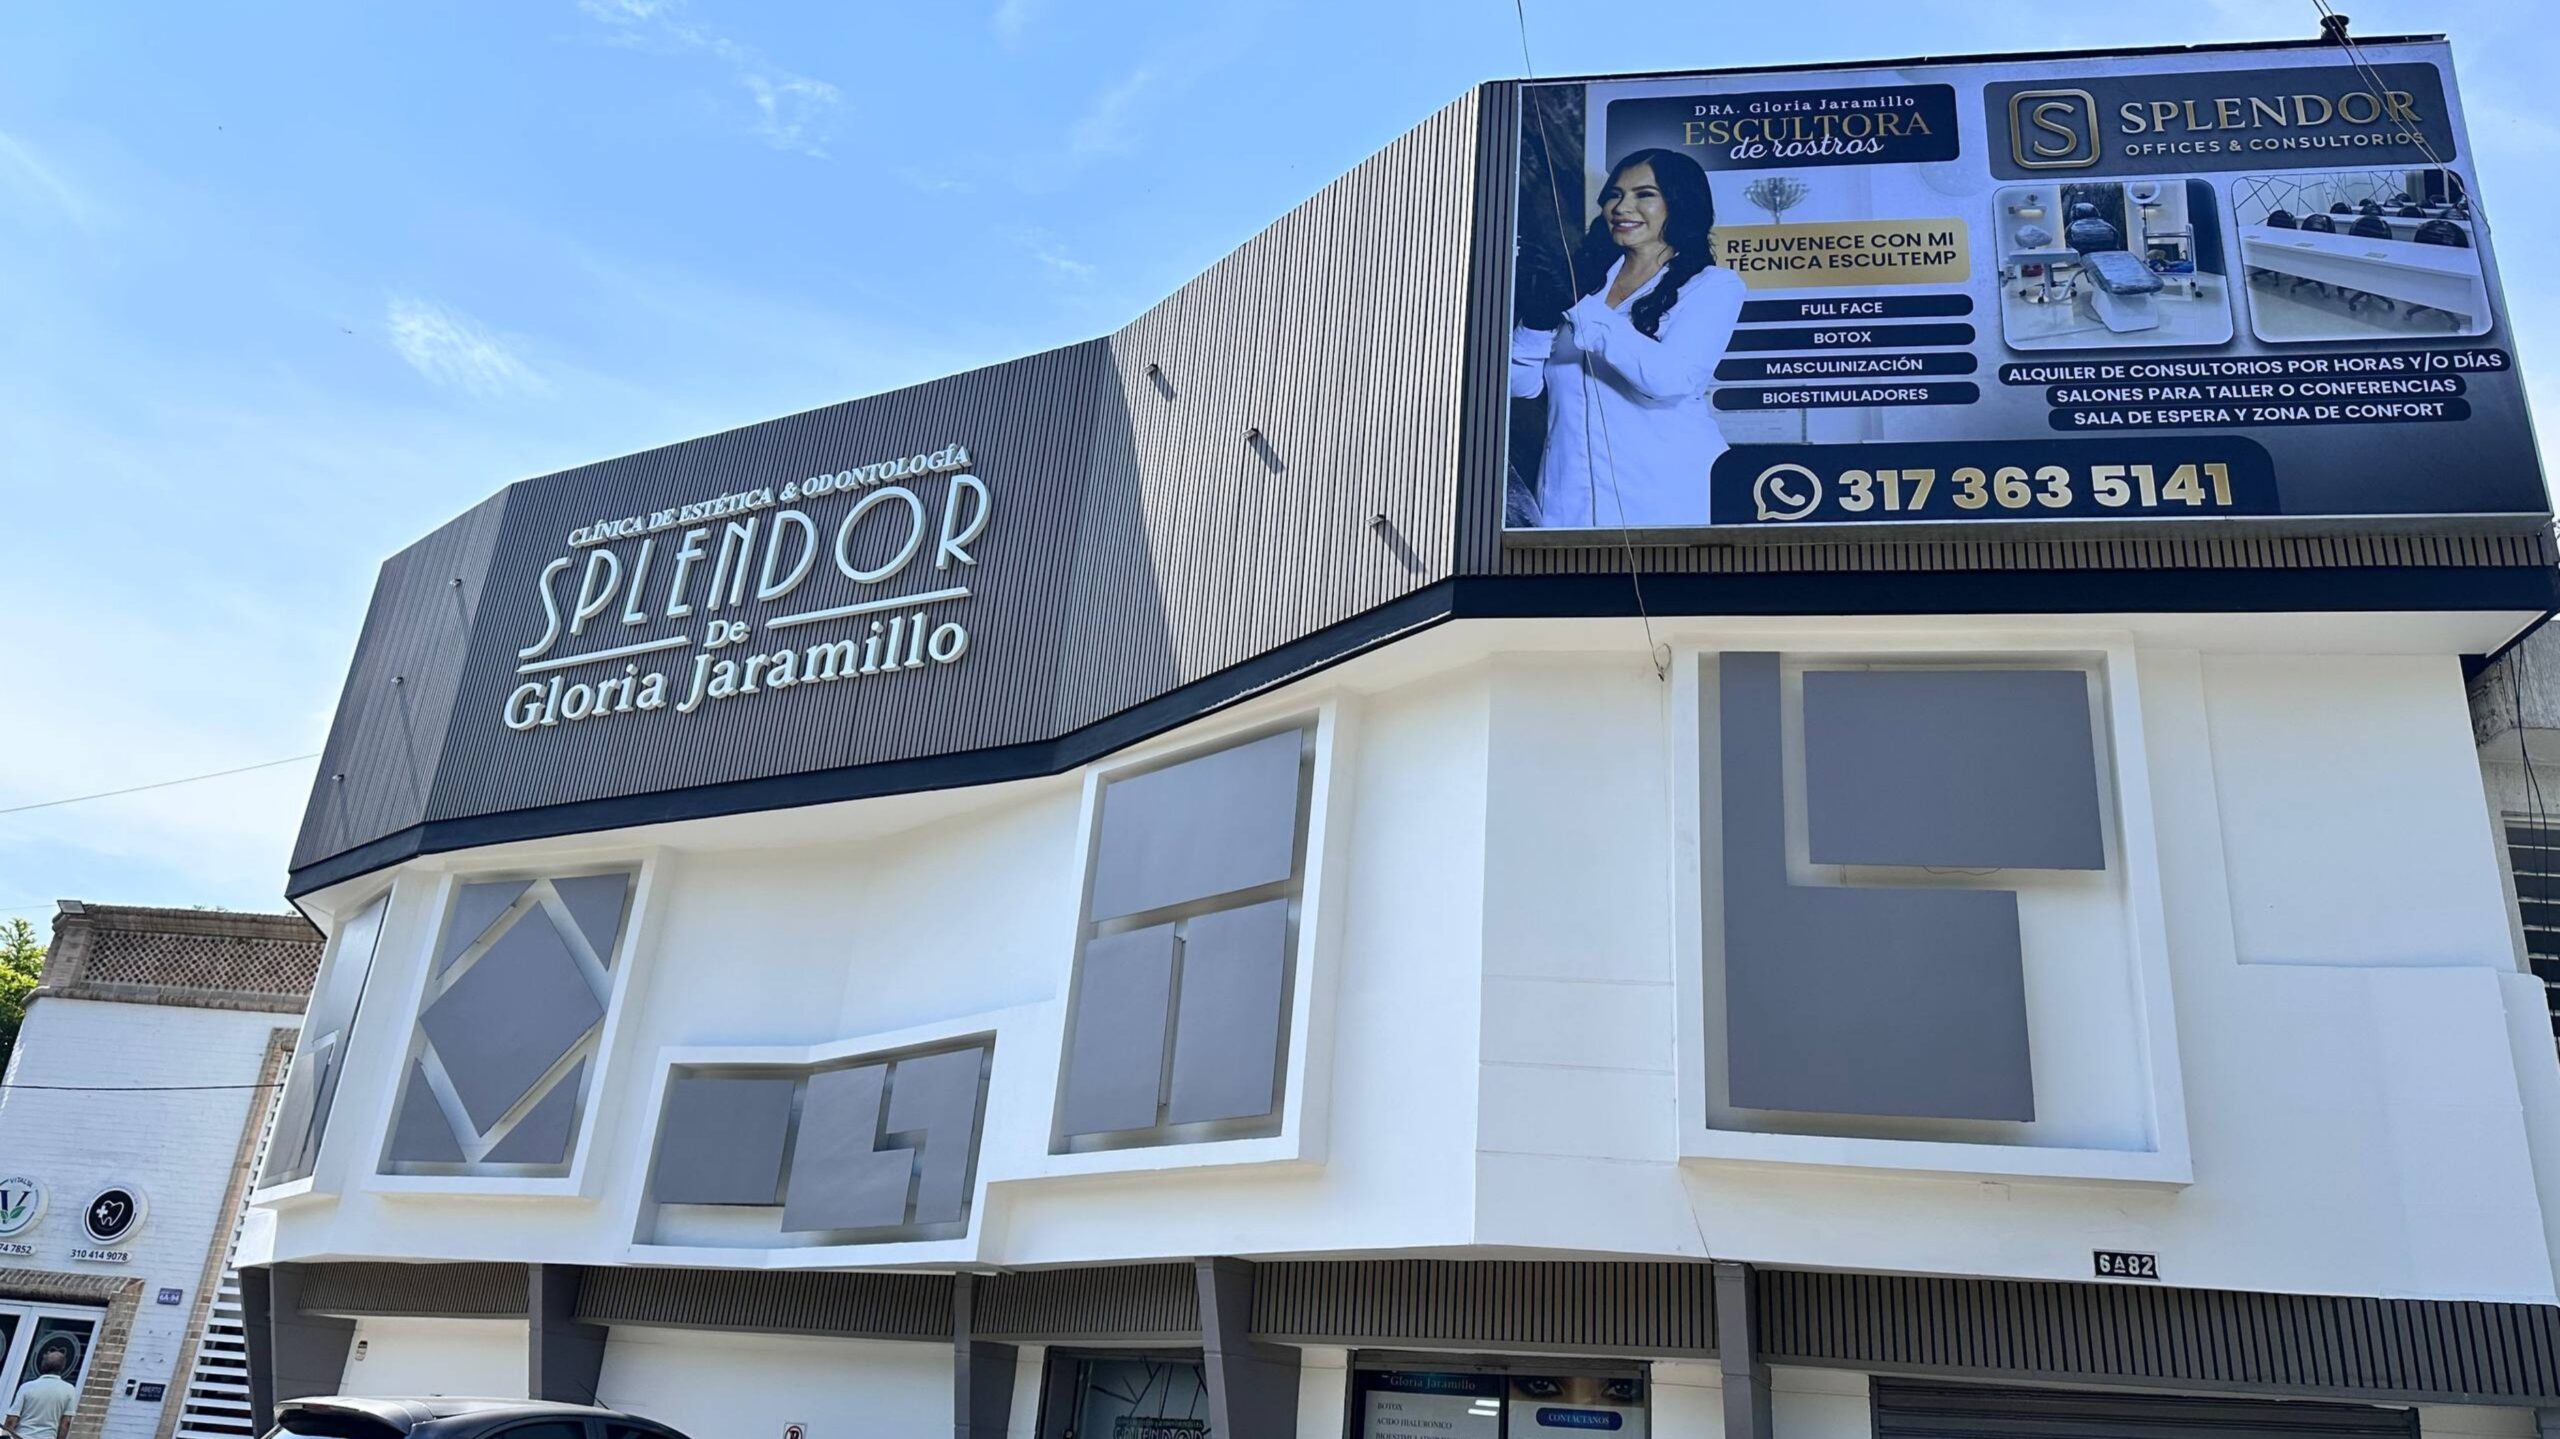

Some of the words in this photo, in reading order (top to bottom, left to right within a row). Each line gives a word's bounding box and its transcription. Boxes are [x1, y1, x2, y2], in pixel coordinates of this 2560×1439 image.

[1694, 104, 1740, 116] DRA.
[1750, 99, 1812, 114] Gloria
[1819, 95, 1914, 110] Jaramillo
[2119, 90, 2423, 135] SPLENDOR
[1683, 111, 1932, 146] ESCULTORA
[1730, 137, 1768, 160] de
[1772, 134, 1884, 158] rostros
[2125, 139, 2220, 156] OFFICES
[2228, 138, 2242, 152] &
[2251, 132, 2425, 151] CONSULTORIOS
[1727, 236, 1865, 254] REJUVENECE
[1871, 233, 1921, 248] CON
[1928, 232, 1954, 246] MI
[1726, 253, 1823, 272] TÉCNICA
[1829, 250, 1956, 269] ESCULTEMP
[1801, 303, 1837, 316] FULL
[1841, 302, 1883, 314] FACE
[1813, 331, 1872, 344] BOTOX
[1766, 356, 1923, 375] MASCULINIZACIÓN
[2008, 366, 2096, 383] ALQUILER
[2101, 365, 2125, 379] DE
[2129, 360, 2283, 378] CONSULTORIOS
[2288, 359, 2329, 373] POR
[2334, 356, 2404, 372] HORAS
[2409, 352, 2449, 372] Y/O
[2454, 351, 2502, 368] DÍAS
[1763, 388, 1929, 404] BIOESTIMULADORES
[2056, 387, 2144, 402] SALONES
[2149, 386, 2202, 400] PARA
[2205, 383, 2274, 399] TALLER
[2279, 383, 2295, 396] O
[2299, 379, 2457, 396] CONFERENCIAS
[2074, 411, 2124, 425] SALA
[2128, 410, 2153, 424] DE
[2157, 408, 2231, 423] ESPERA
[2234, 408, 2248, 422] Y
[2252, 406, 2311, 421] ZONA
[2314, 405, 2341, 419] DE
[2345, 402, 2445, 418] CONFORT
[567, 514, 646, 548] CLÍNICA
[647, 505, 679, 532] DE
[677, 485, 777, 525] ESTÉTICA
[779, 482, 800, 503] &
[801, 443, 972, 498] ODONTOLOGÍA
[1838, 468, 1936, 512] 317
[1951, 466, 2073, 510] 363
[2090, 462, 2233, 507] 5141
[518, 473, 992, 660] SPLENDOR
[703, 618, 752, 649] De
[502, 662, 668, 731] Gloria
[676, 611, 969, 714] Jaramillo
[10, 1244, 32, 1254] 7852
[71, 1249, 87, 1258] 310
[88, 1250, 104, 1260] 414
[106, 1251, 128, 1261] 9078
[2099, 1254, 2154, 1276] 6A82
[1390, 1376, 1423, 1387] Gloria
[1426, 1378, 1476, 1391] Jaramillo
